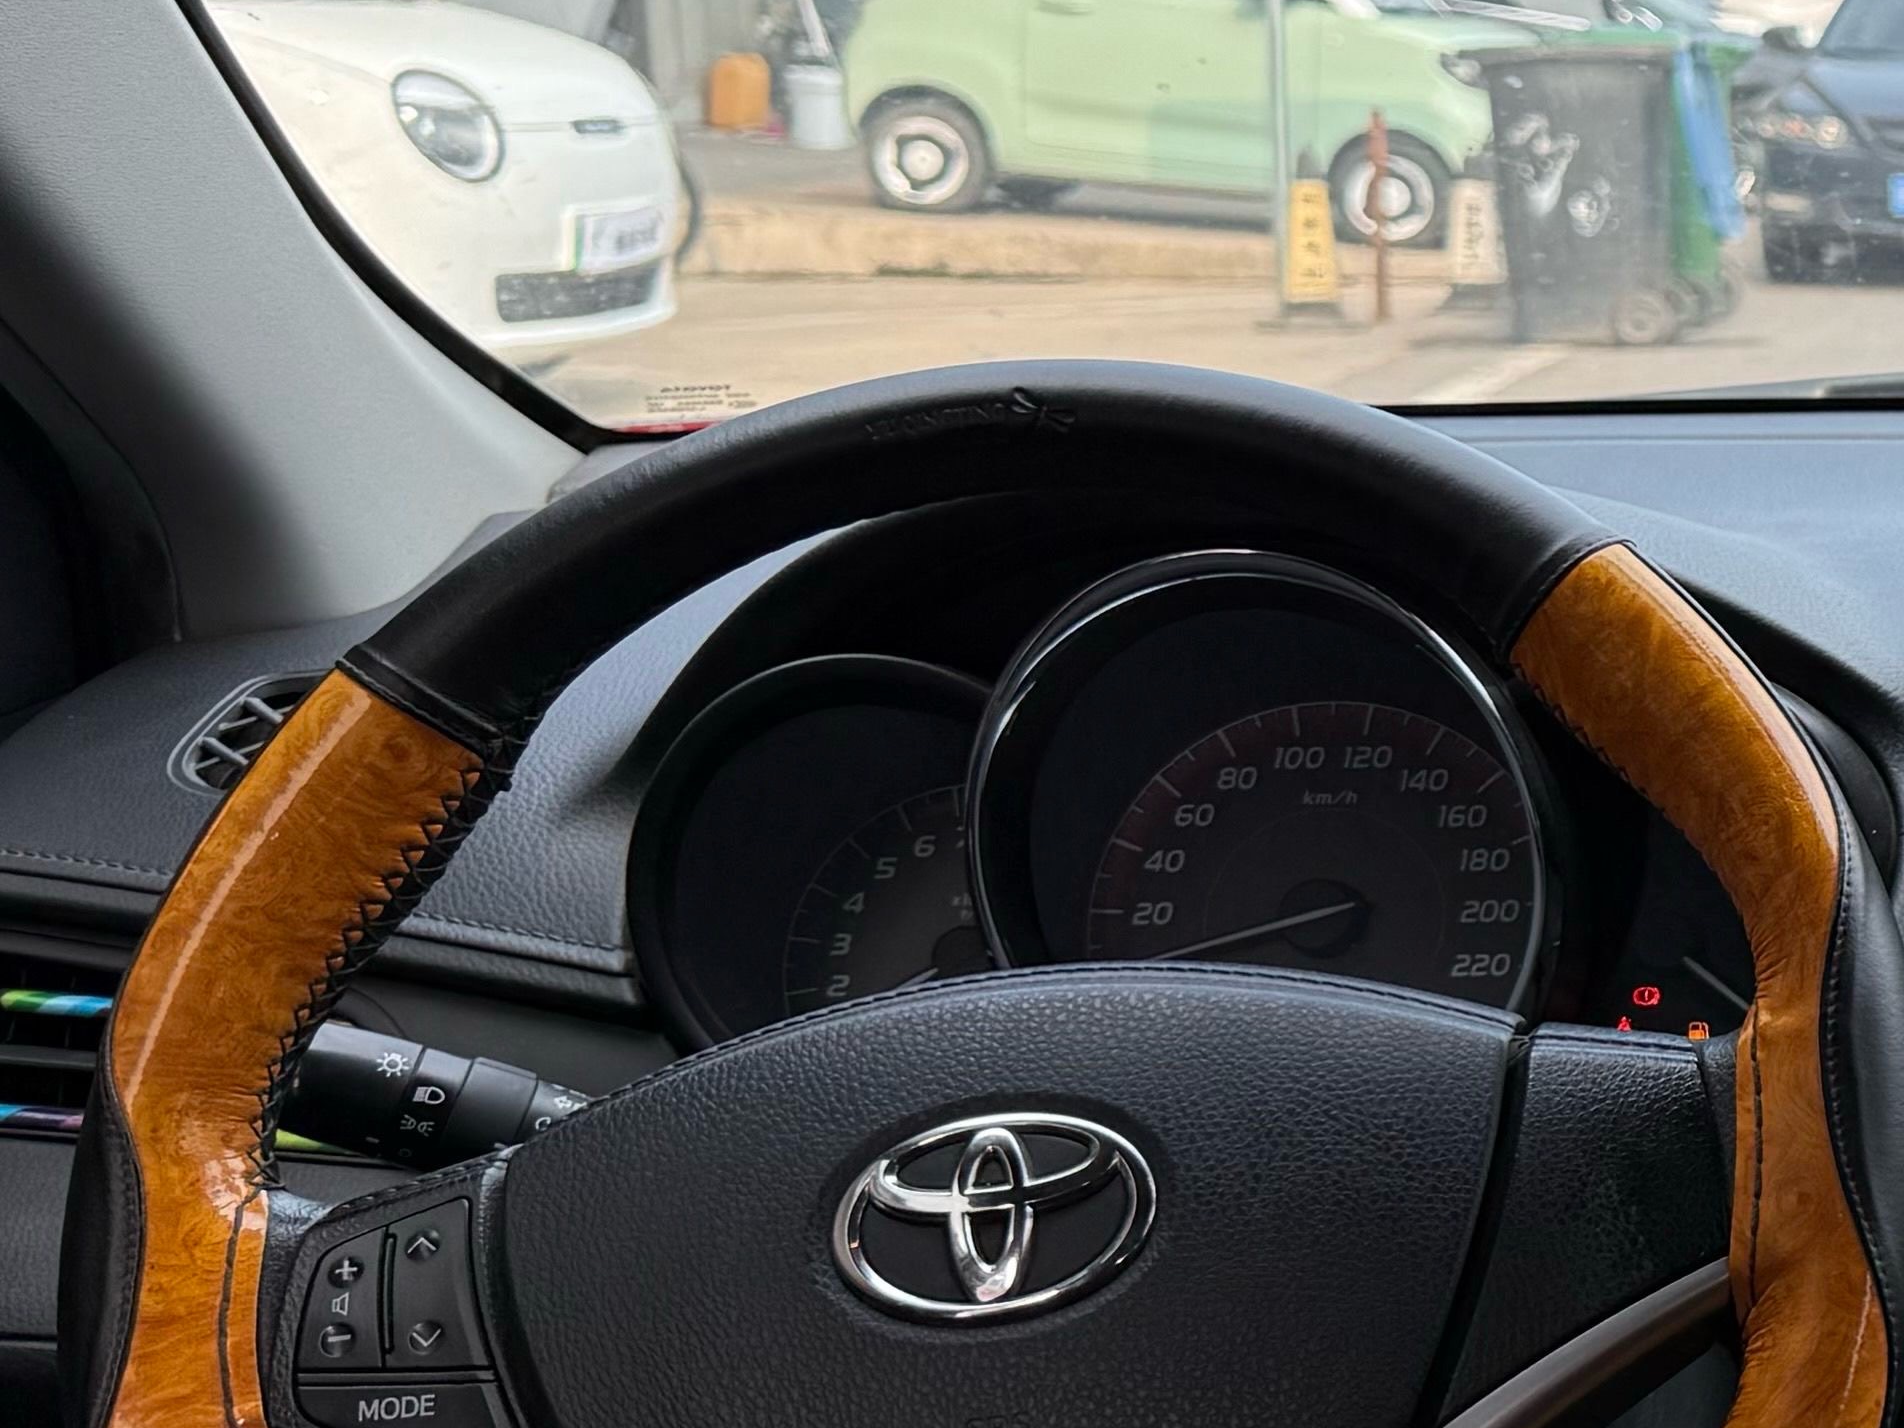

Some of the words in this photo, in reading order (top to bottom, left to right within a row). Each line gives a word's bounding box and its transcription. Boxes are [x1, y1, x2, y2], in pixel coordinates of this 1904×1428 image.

[1273, 746, 1326, 770] 100
[1343, 745, 1393, 769] 120
[1217, 766, 1259, 790] 80
[1399, 768, 1450, 793] 140
[1302, 789, 1359, 807] km/h
[1174, 803, 1215, 828] 60
[1437, 804, 1488, 828] 160
[912, 834, 937, 859] 6
[873, 856, 898, 880] 5
[1143, 848, 1186, 874] 40
[1460, 848, 1511, 873] 180
[842, 891, 866, 915] 4
[1131, 901, 1175, 927] 20
[1459, 899, 1521, 924] 200
[829, 932, 853, 957] 3
[1450, 953, 1512, 978] 220
[825, 974, 851, 998] 2
[356, 1393, 437, 1424] MODE
